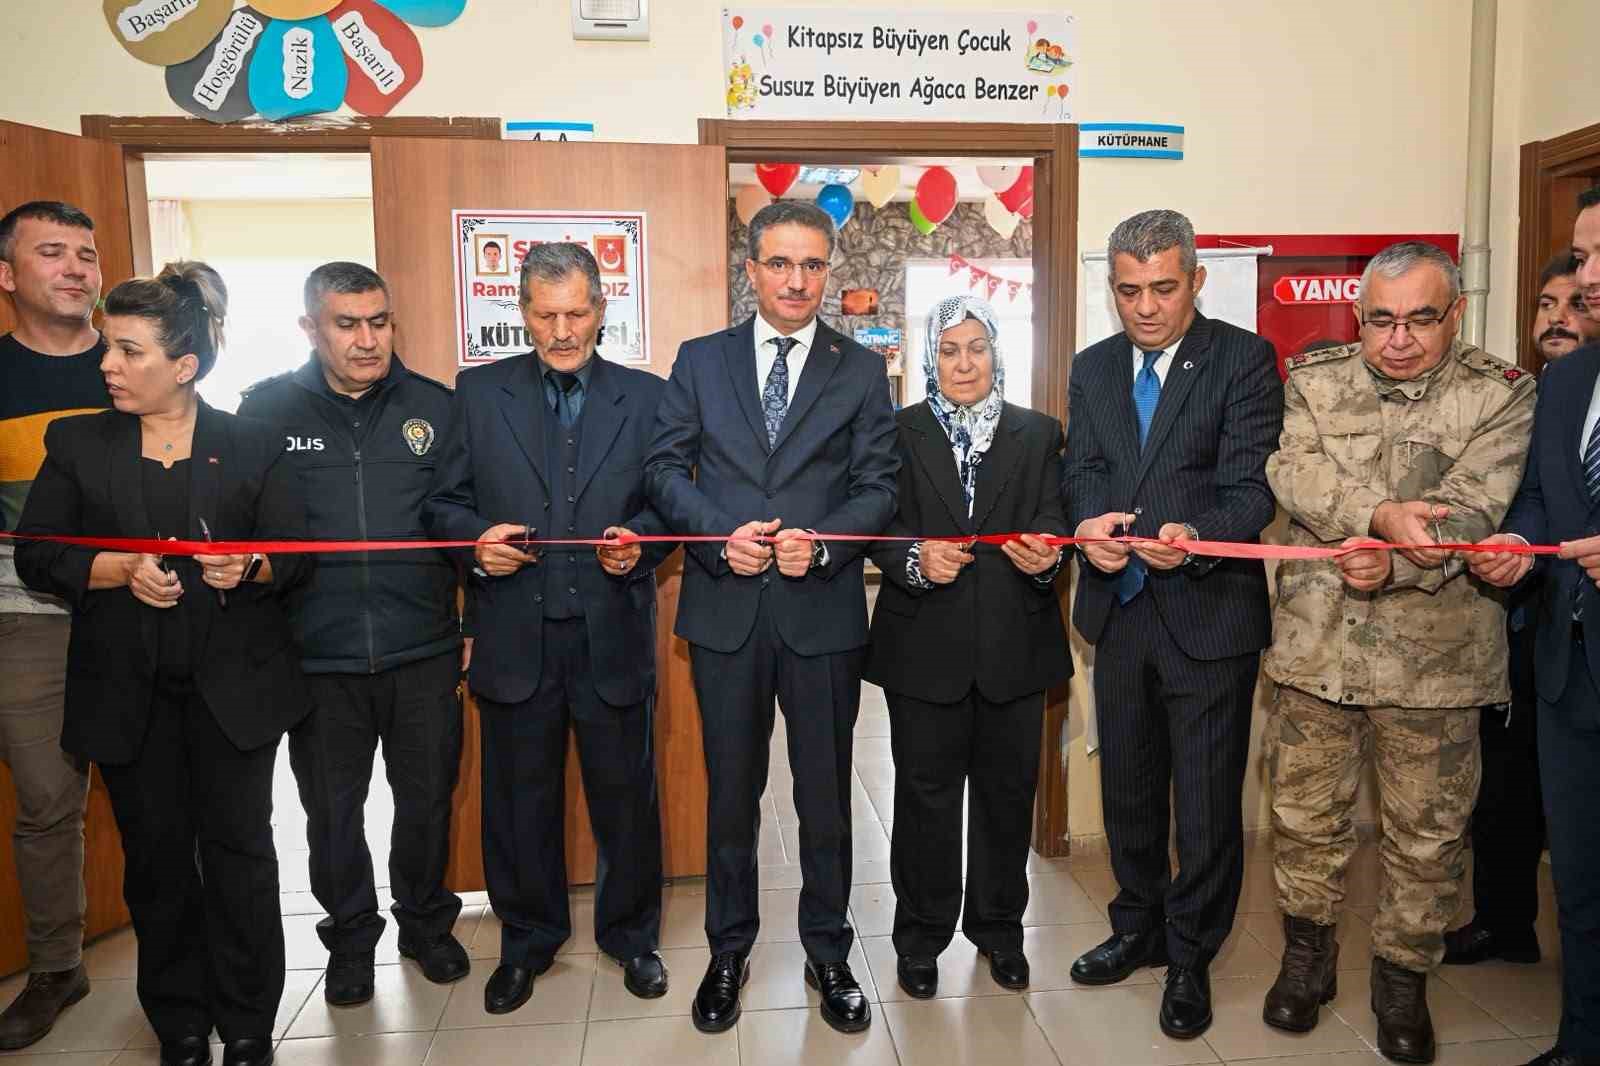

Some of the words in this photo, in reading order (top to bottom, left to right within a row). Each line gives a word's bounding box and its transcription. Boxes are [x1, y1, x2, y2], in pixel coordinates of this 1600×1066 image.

[341, 21, 394, 88] Başarılı
[788, 26, 863, 54] Kitapsız
[873, 28, 948, 56] Büyüyen
[957, 29, 1012, 53] Çocuk
[198, 16, 258, 103] Hoşgörülü
[290, 37, 309, 92] Nazik
[759, 75, 815, 98] Susuz
[824, 76, 901, 104] Büyüyen
[910, 78, 965, 106] Ağaca
[976, 78, 1039, 102] Benzer
[1097, 133, 1168, 148] KÜTÜPHANE
[1289, 279, 1361, 301] YANG
